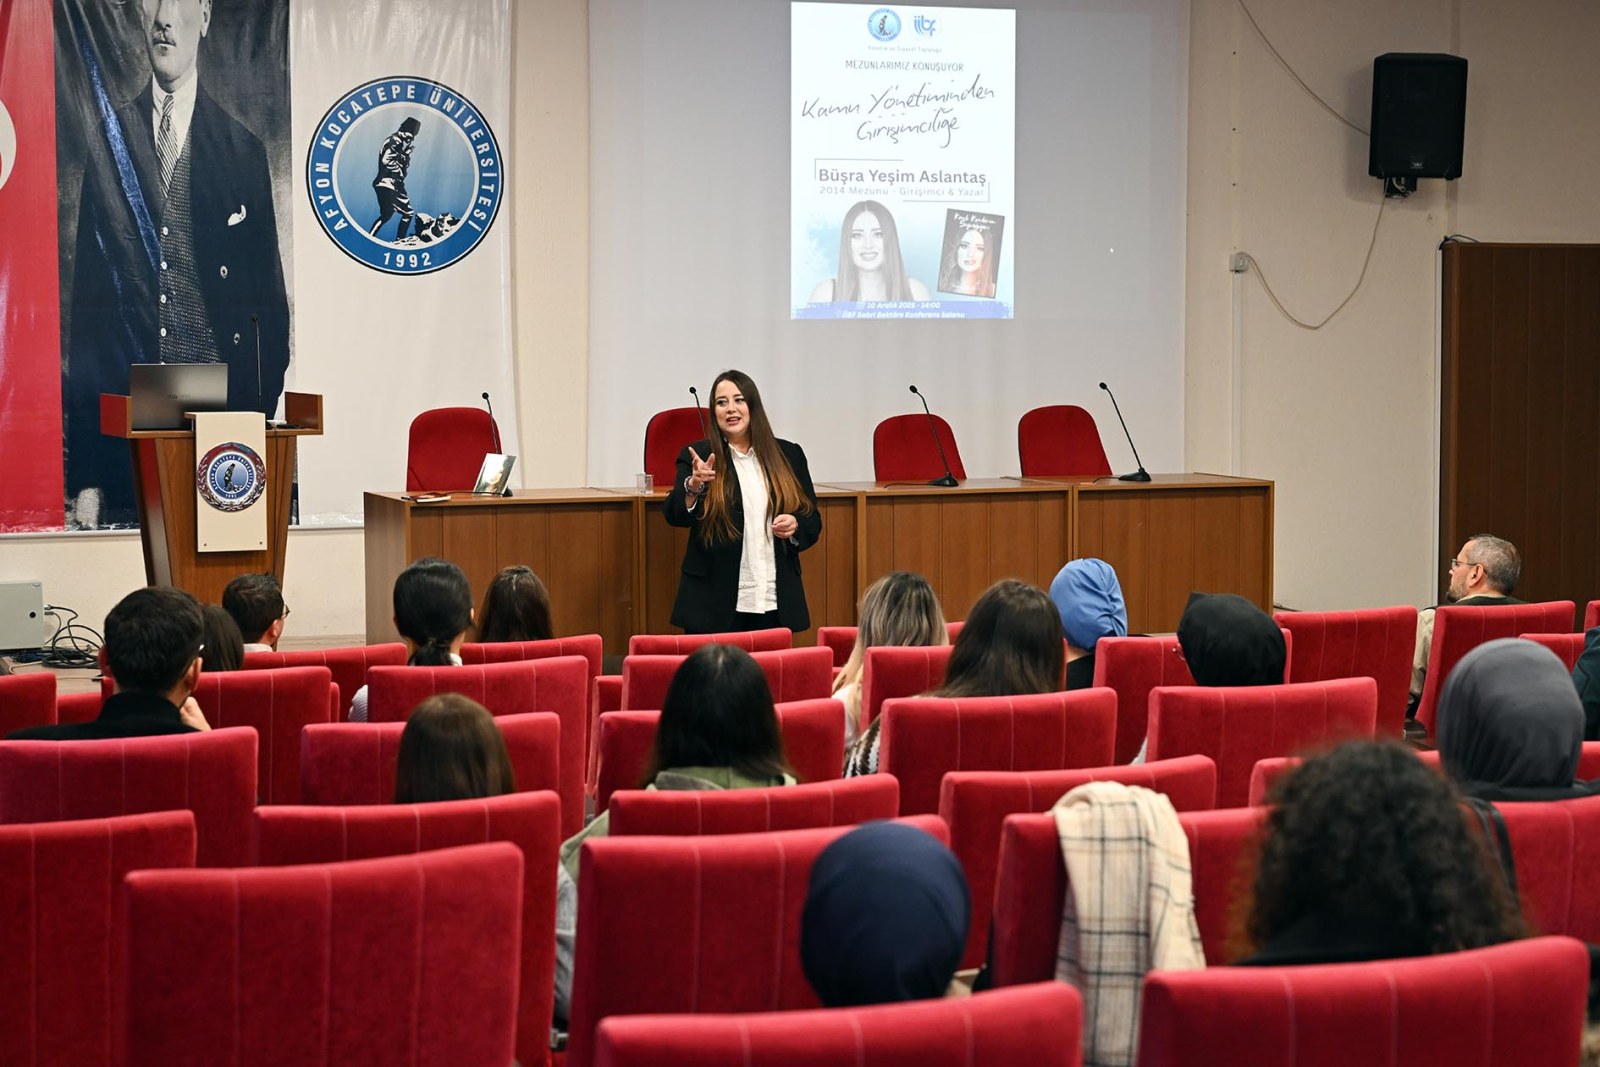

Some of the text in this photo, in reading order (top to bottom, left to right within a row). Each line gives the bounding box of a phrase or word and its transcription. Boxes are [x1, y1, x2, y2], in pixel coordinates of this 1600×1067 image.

[845, 60, 964, 73] MEZUNLARIMIZ KONUŞUYOR
[801, 73, 995, 119] Kamu Yönetiminden
[856, 107, 960, 149] Girişimciliğe
[315, 84, 498, 232] AFYON KOCATEPE ÜNİVERSİTESİ
[819, 168, 987, 187] Büşra Yeşim Aslantaş
[819, 186, 845, 195] 2014
[849, 186, 889, 195] Mezunu
[947, 187, 954, 196] &
[383, 252, 432, 268] 1992
[904, 311, 939, 319] Konferans
